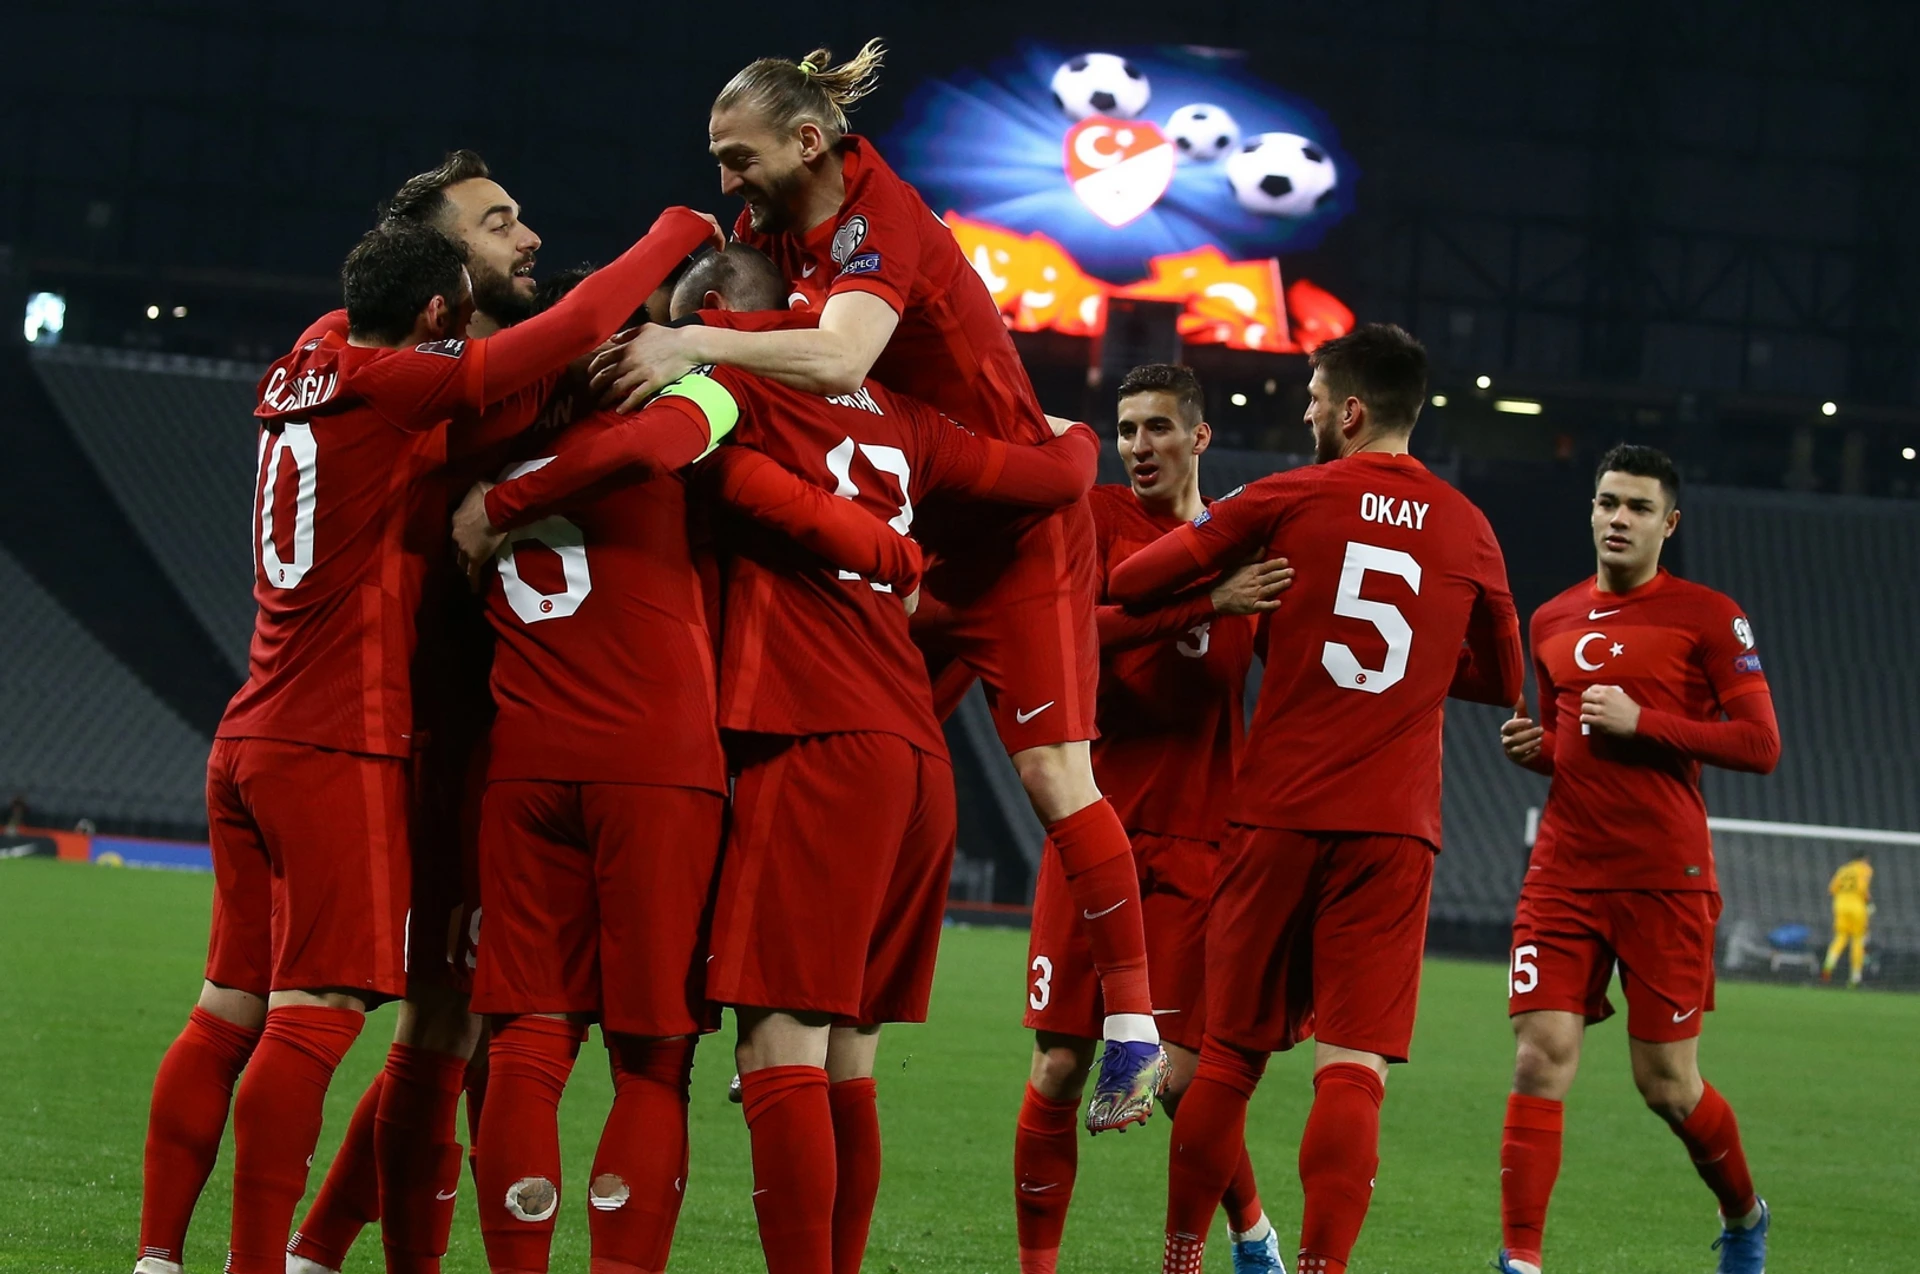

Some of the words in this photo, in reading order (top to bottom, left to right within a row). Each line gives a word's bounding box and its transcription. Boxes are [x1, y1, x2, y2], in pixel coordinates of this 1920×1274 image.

[1360, 492, 1430, 530] OKAY
[1321, 541, 1422, 694] 5
[1029, 955, 1053, 1011] 3
